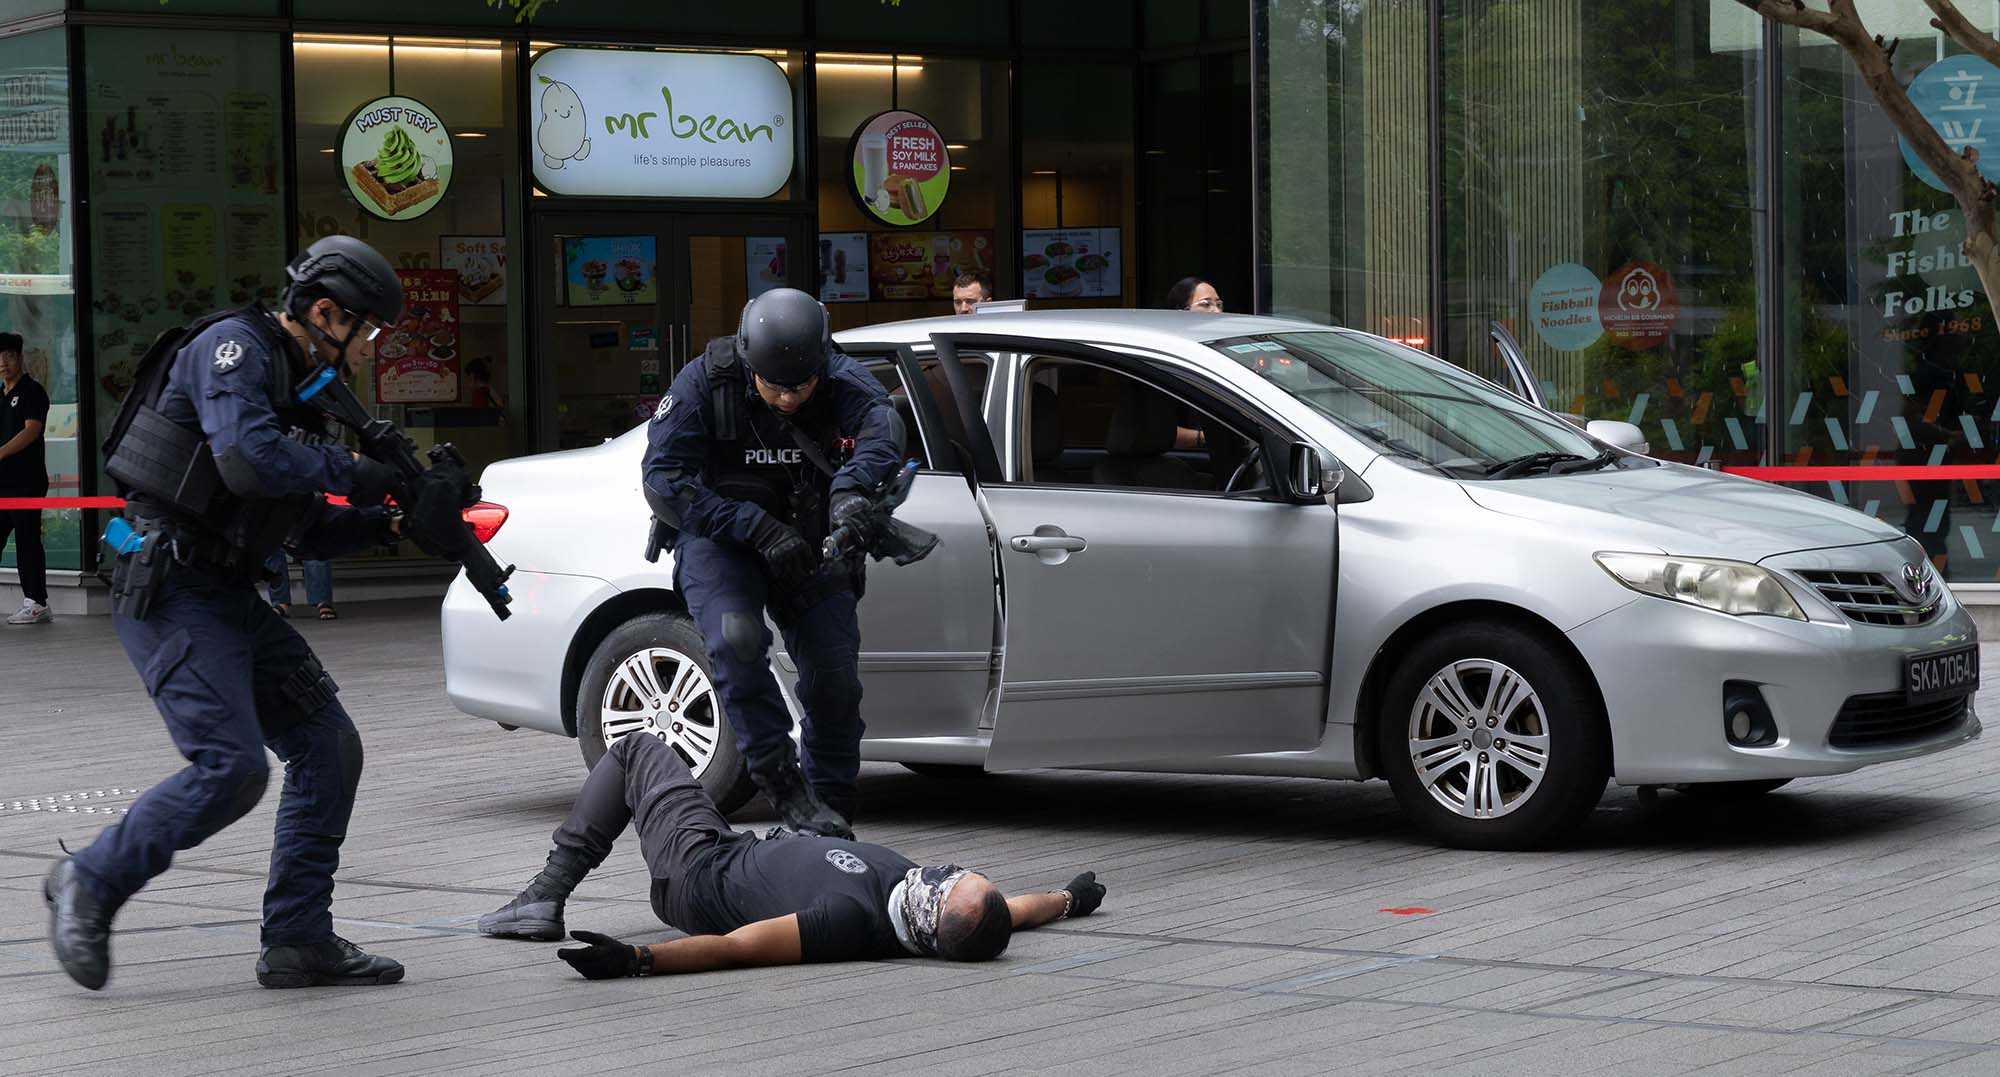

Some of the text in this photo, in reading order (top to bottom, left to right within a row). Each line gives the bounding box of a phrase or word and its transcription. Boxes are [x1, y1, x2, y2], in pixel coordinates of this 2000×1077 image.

[356, 107, 438, 133] MUST TRY
[604, 111, 657, 140] mr
[902, 121, 928, 129] SELLER
[893, 137, 935, 151] FRESH
[633, 154, 751, 168] life's simple pleasures
[892, 151, 937, 162] SOY MILK
[892, 162, 938, 171] & PANCAKES
[1889, 208, 1950, 238] The
[456, 241, 485, 254] Soft
[1542, 296, 1593, 313] Fishball
[1883, 284, 1975, 318] Folks
[1540, 313, 1593, 329] Noodles
[1881, 317, 1982, 342] Since 1968
[745, 448, 802, 464] POLICE
[1911, 650, 1977, 692] SKA7064J
